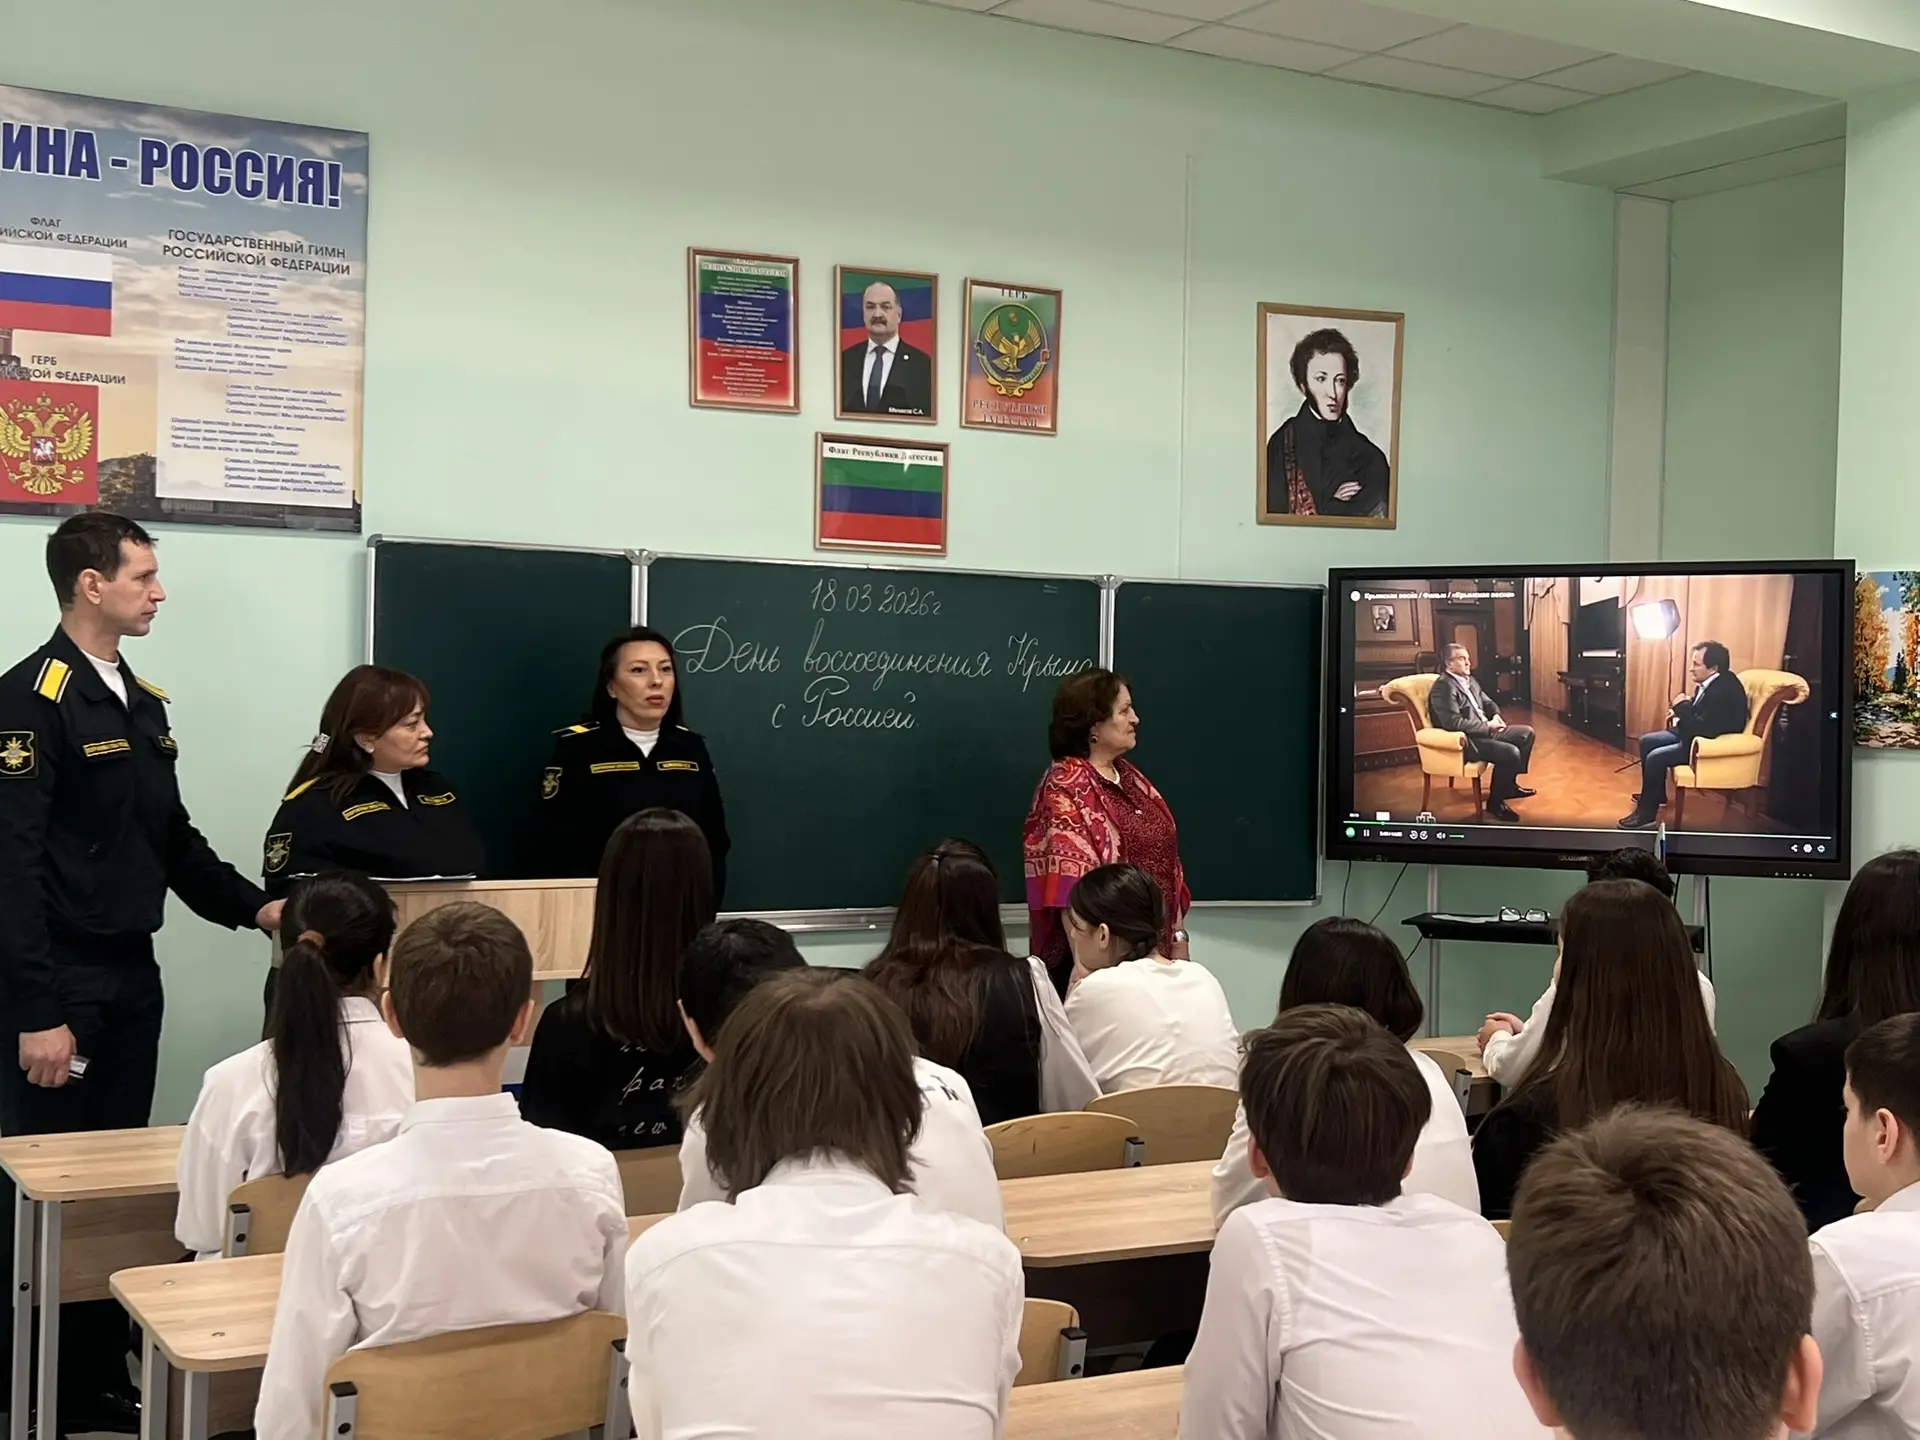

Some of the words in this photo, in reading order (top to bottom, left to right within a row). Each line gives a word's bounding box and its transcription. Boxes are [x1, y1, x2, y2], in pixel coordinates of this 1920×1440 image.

[1, 121, 101, 181] ИНА
[109, 156, 130, 170] -
[138, 137, 344, 210] РОССИЯ!
[29, 216, 62, 228] ФЛАГ
[56, 233, 128, 249] ФЕДЕРАЦИИ
[168, 228, 304, 254] ГОСУДАРСТВЕННЫЙ
[307, 244, 346, 259] ГИМН
[163, 245, 266, 267] РОССИЙСКОЙ
[270, 257, 351, 276] ФЕДЕРАЦИИ
[31, 354, 58, 366] ГЕРБ
[55, 370, 127, 385] ФЕДЕРАЦИИ
[828, 445, 849, 456] Флаг
[852, 447, 899, 460] Республики
[672, 616, 781, 674] День
[803, 617, 993, 692] воссоединения
[771, 703, 786, 729] с
